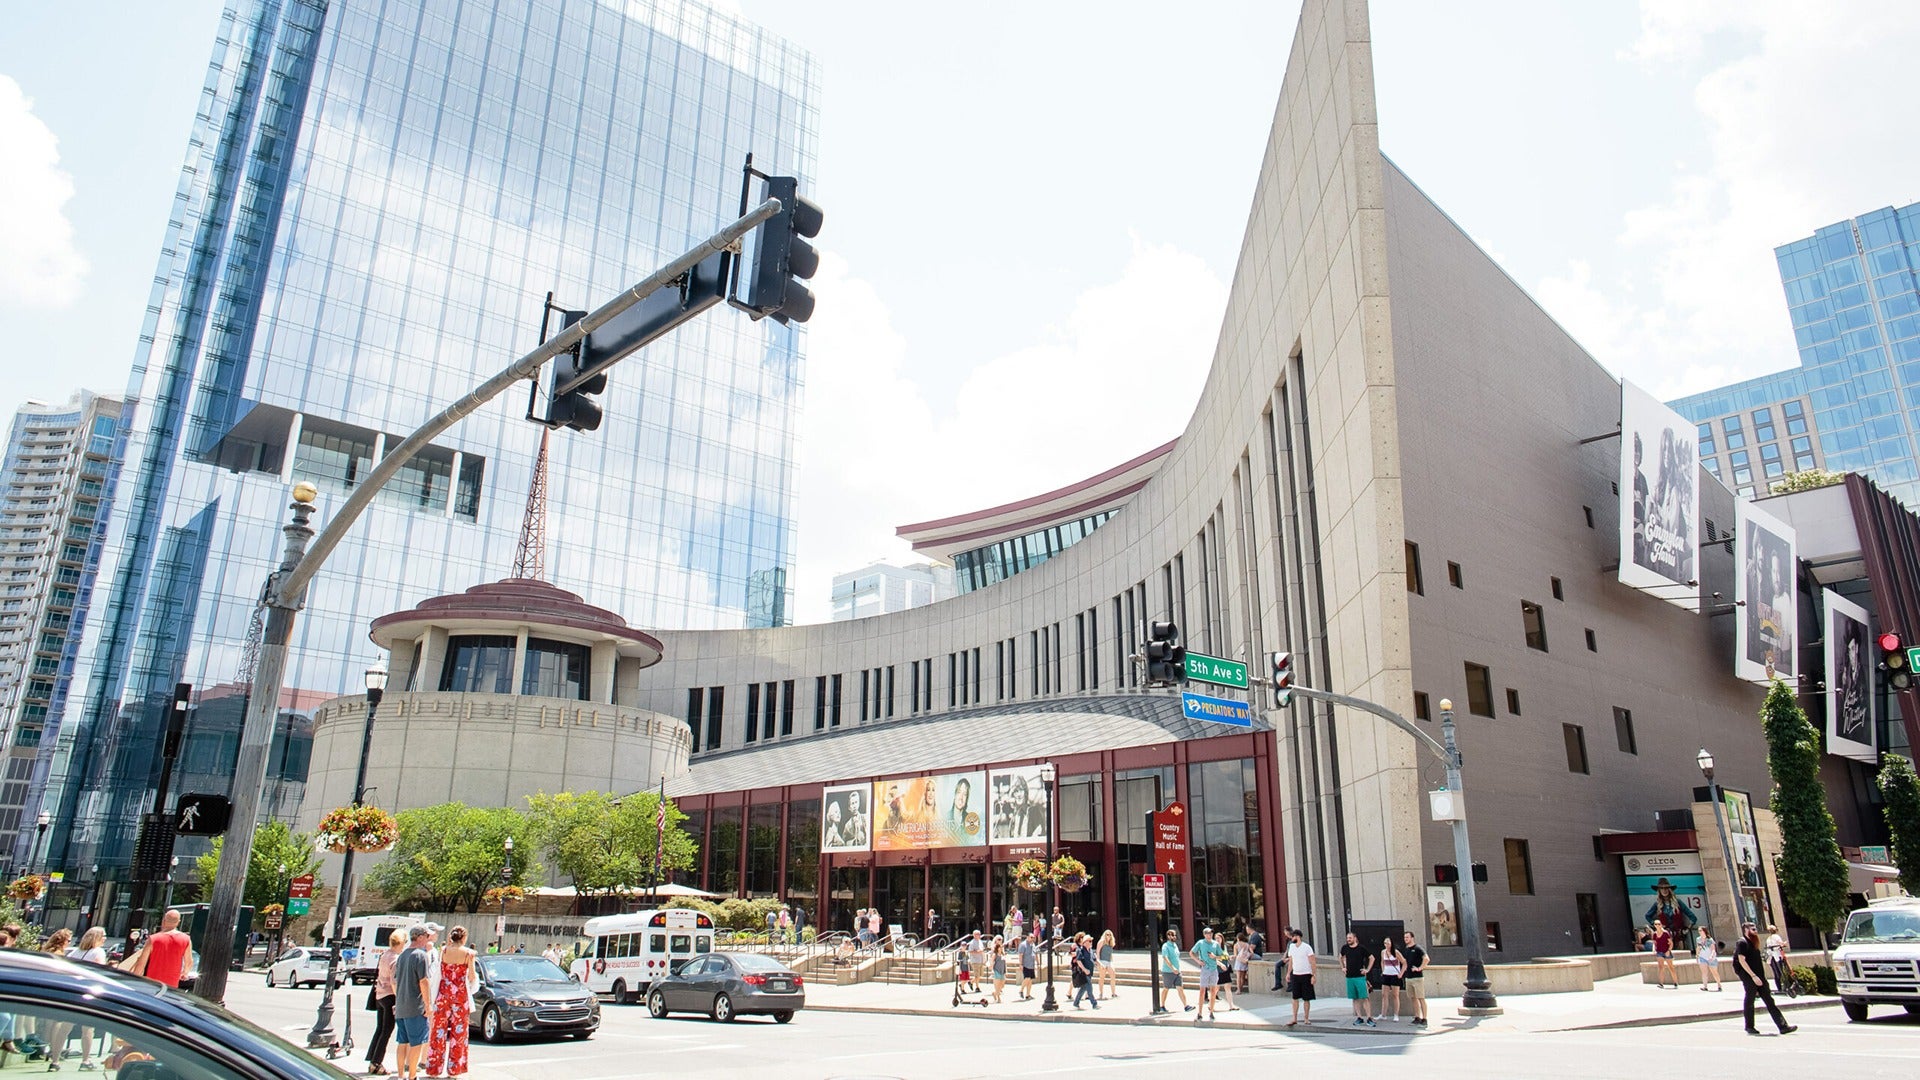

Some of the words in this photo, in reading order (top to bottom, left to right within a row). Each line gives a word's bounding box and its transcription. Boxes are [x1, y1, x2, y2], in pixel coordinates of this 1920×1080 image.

[1190, 659, 1208, 675] 5th
[1213, 664, 1232, 679] Ave
[1235, 668, 1243, 681] S
[1202, 702, 1236, 718] PREDATORS
[1237, 707, 1249, 719] WAY
[1159, 823, 1180, 833] Country
[1166, 842, 1172, 850] of
[1687, 897, 1701, 908] 13
[520, 924, 537, 935] MUSIC
[539, 924, 552, 936] HALL
[553, 925, 562, 936] OF
[563, 925, 579, 937] FAME
